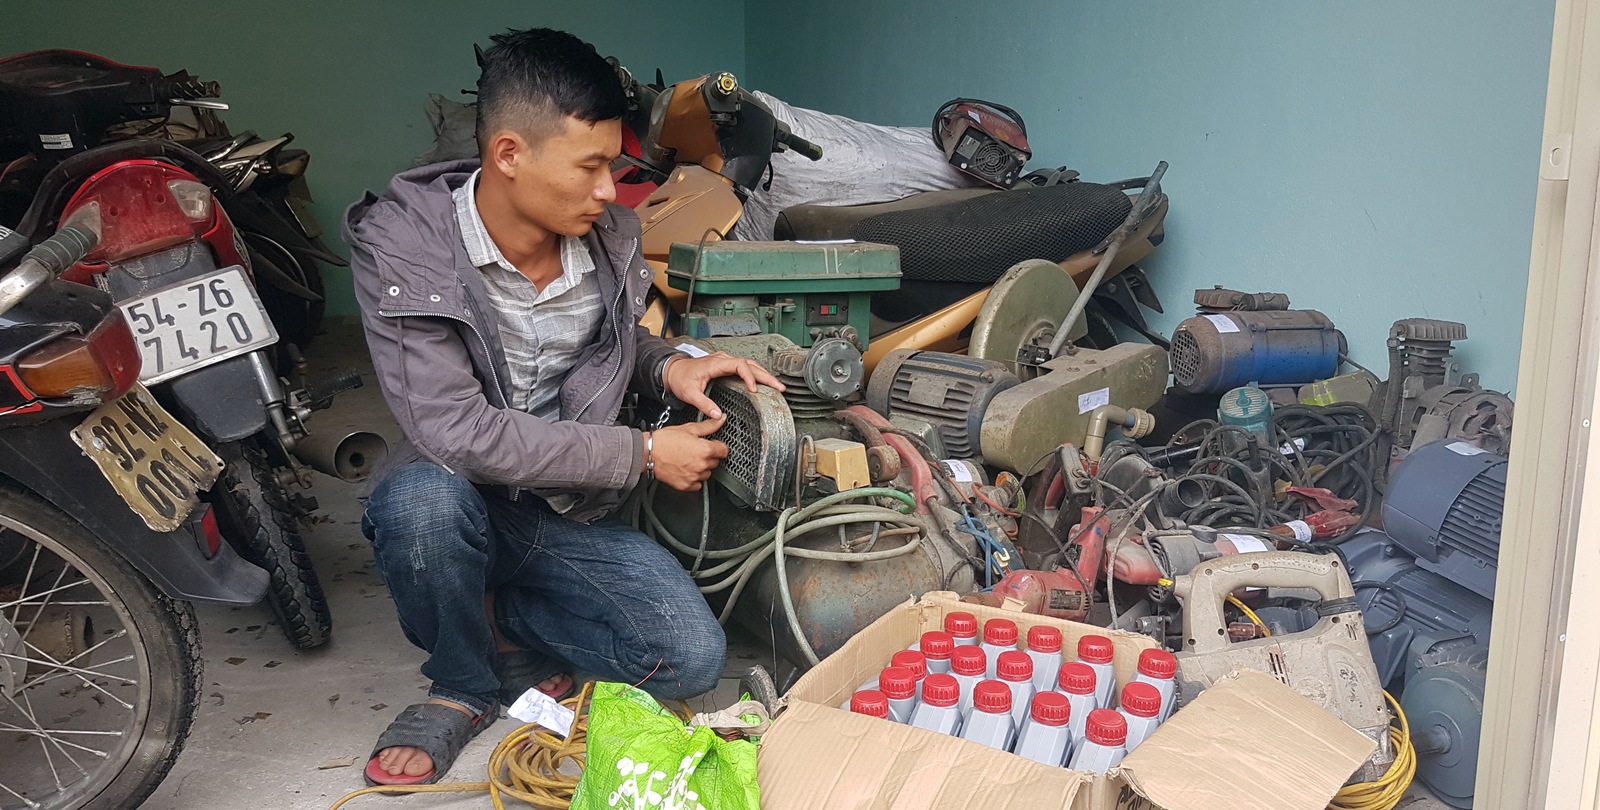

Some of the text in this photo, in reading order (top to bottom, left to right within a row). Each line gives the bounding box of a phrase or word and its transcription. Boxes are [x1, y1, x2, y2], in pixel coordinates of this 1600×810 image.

[128, 278, 235, 335] 54-Z6
[143, 312, 253, 373] 7420
[92, 391, 169, 472] 92-N2
